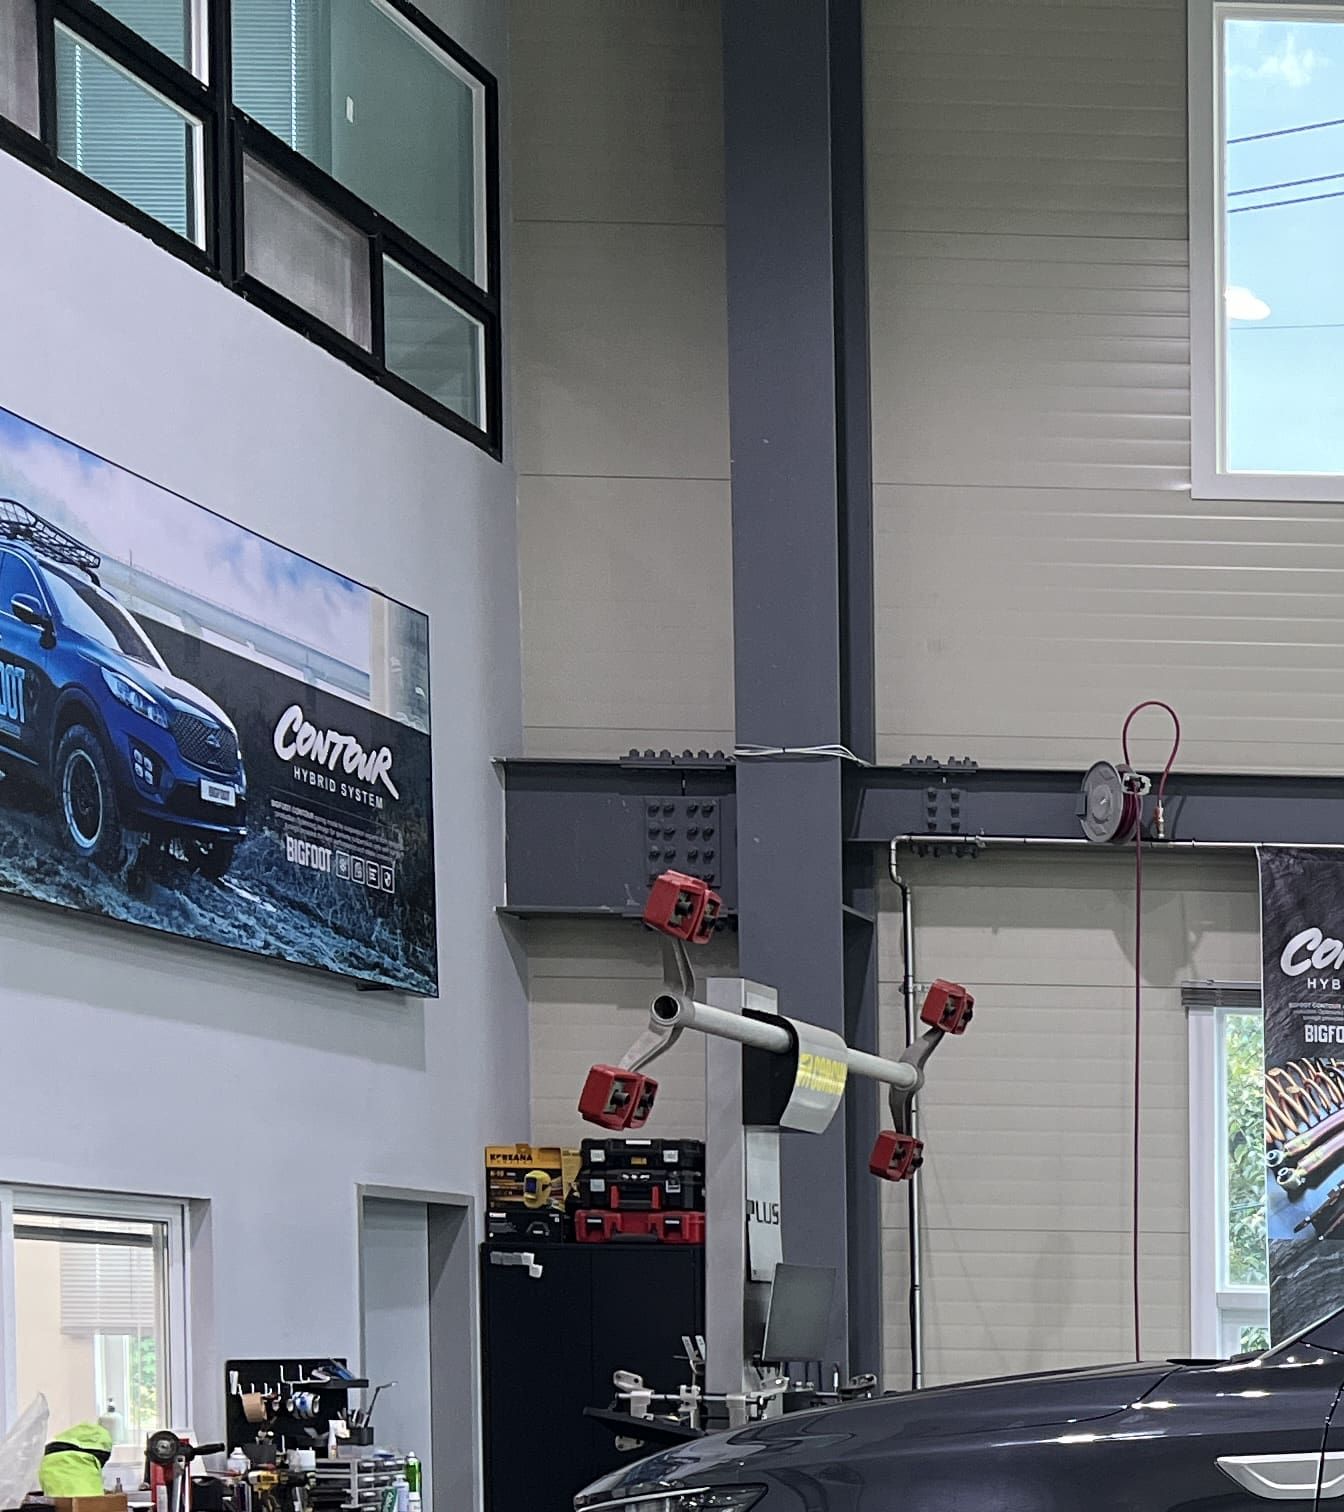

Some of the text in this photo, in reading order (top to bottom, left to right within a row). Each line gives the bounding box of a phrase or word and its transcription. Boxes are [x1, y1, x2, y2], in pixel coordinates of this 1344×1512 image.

[293, 765, 384, 810] HYBRID SYSTEM
[286, 836, 333, 873] BIGFOOT
